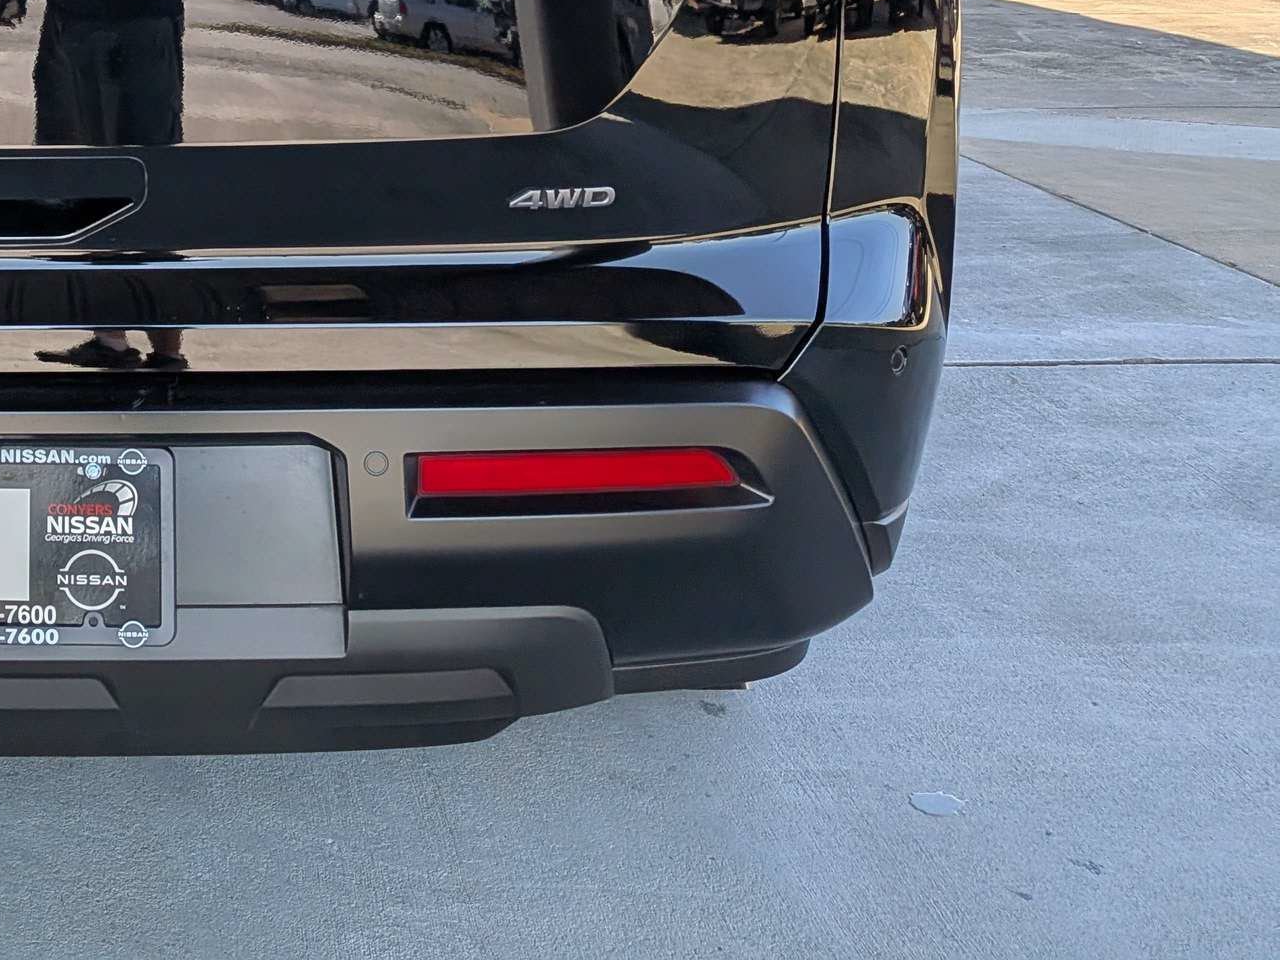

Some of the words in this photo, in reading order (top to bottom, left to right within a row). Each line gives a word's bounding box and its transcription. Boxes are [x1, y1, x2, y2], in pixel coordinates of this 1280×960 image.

[509, 186, 616, 210] 4WD
[48, 503, 112, 515] CONYERS
[47, 516, 133, 534] NISSAN
[45, 533, 81, 544] Georgia's
[82, 534, 110, 545] Driving
[111, 534, 134, 544] Force
[57, 574, 128, 586] NISSAN
